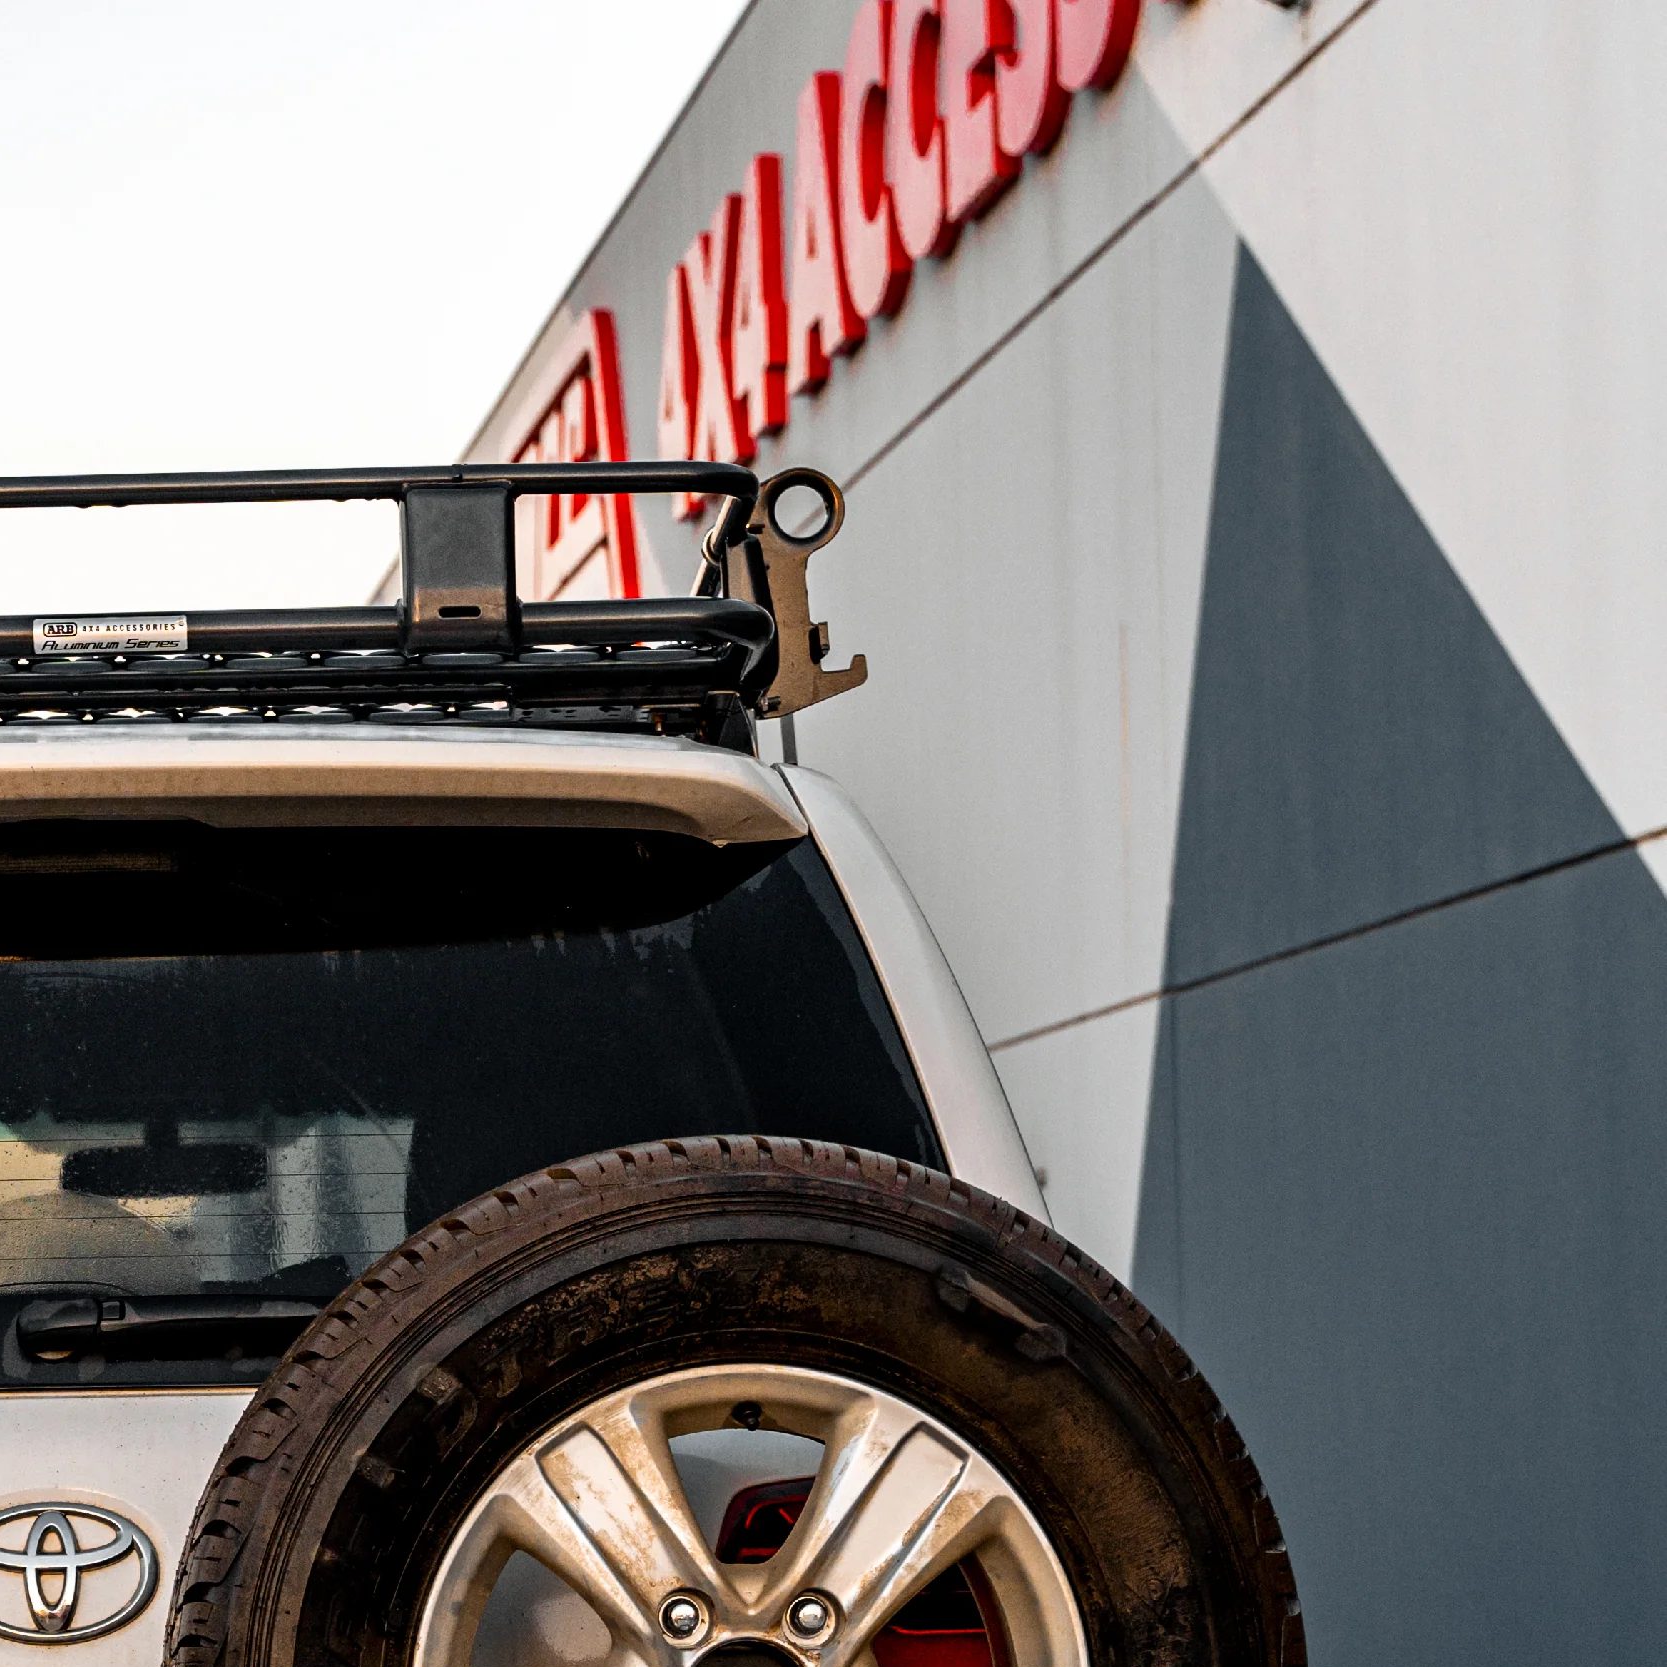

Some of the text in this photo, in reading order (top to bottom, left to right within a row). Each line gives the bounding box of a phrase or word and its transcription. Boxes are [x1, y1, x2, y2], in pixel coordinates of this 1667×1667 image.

[46, 624, 75, 635] ARB
[105, 622, 176, 633] ACCESSORIES
[123, 638, 181, 649] Series
